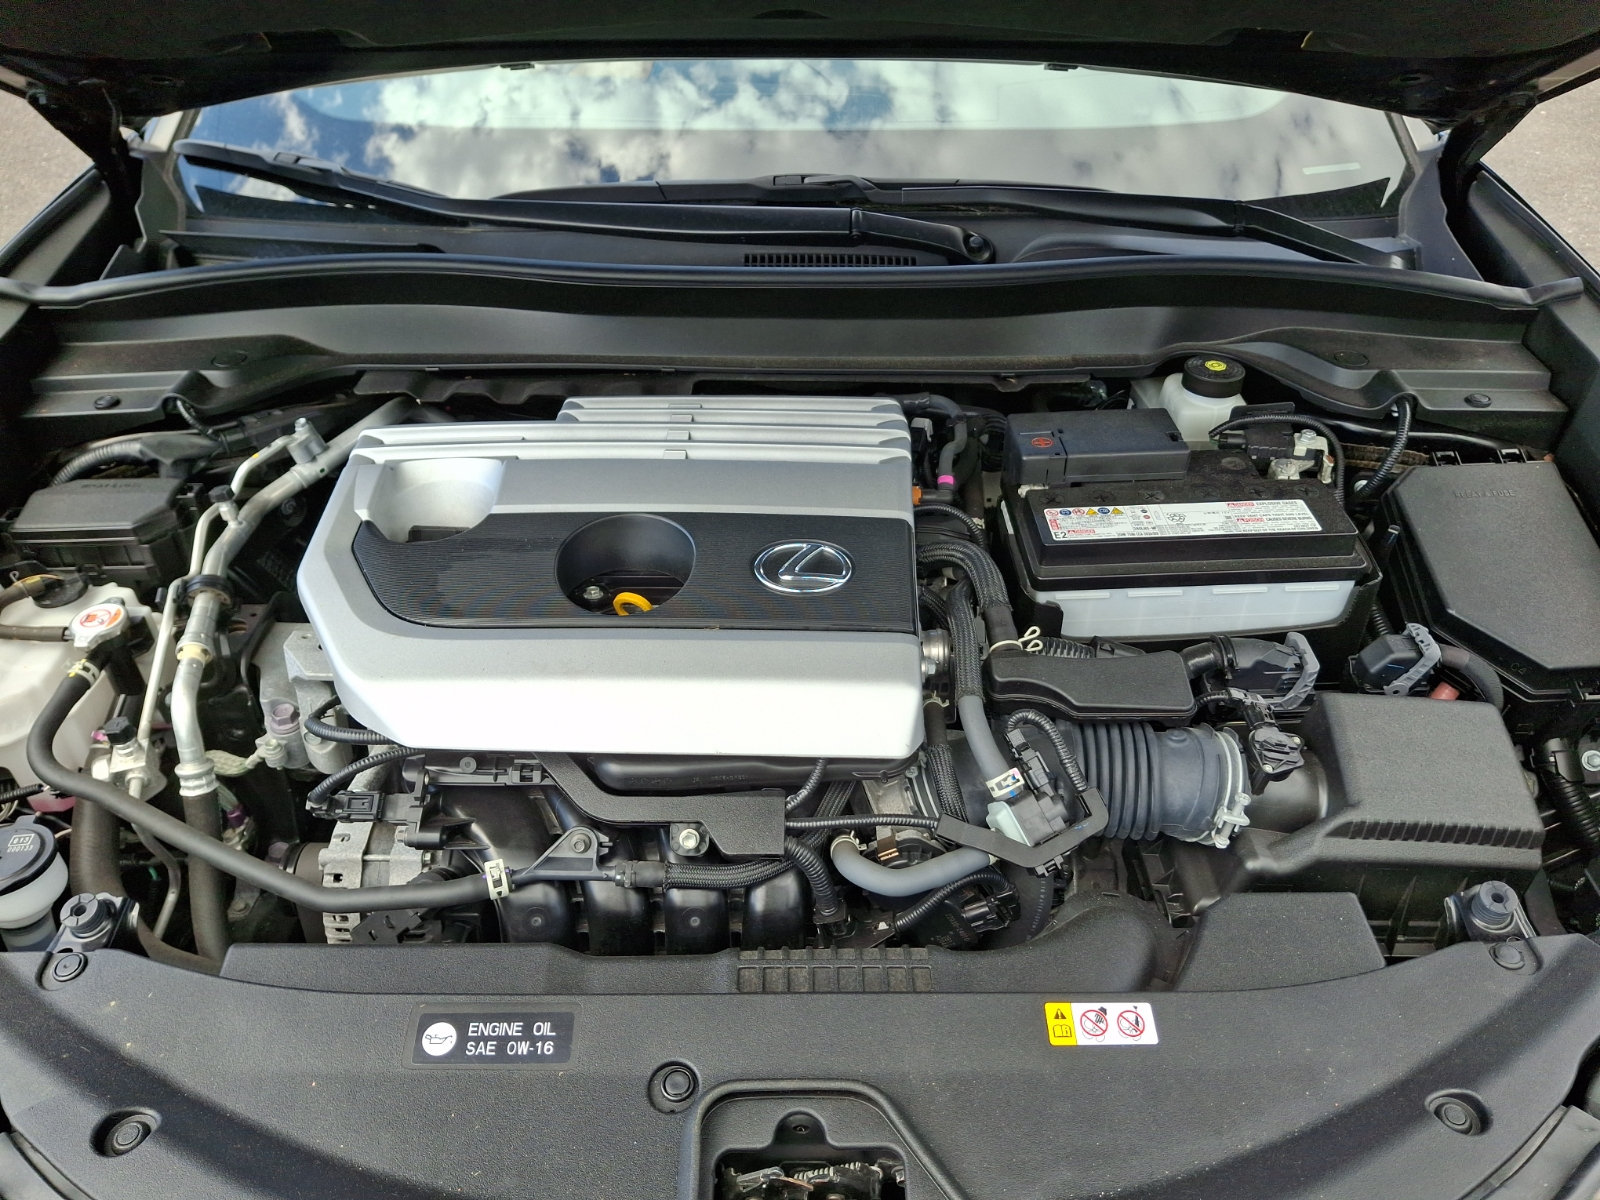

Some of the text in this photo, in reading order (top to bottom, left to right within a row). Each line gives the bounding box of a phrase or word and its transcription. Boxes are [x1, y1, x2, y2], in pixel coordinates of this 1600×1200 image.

[1053, 531, 1068, 539] E2
[468, 1022, 557, 1036] ENGINE OIL
[465, 1041, 555, 1056] SAE 0W-16
